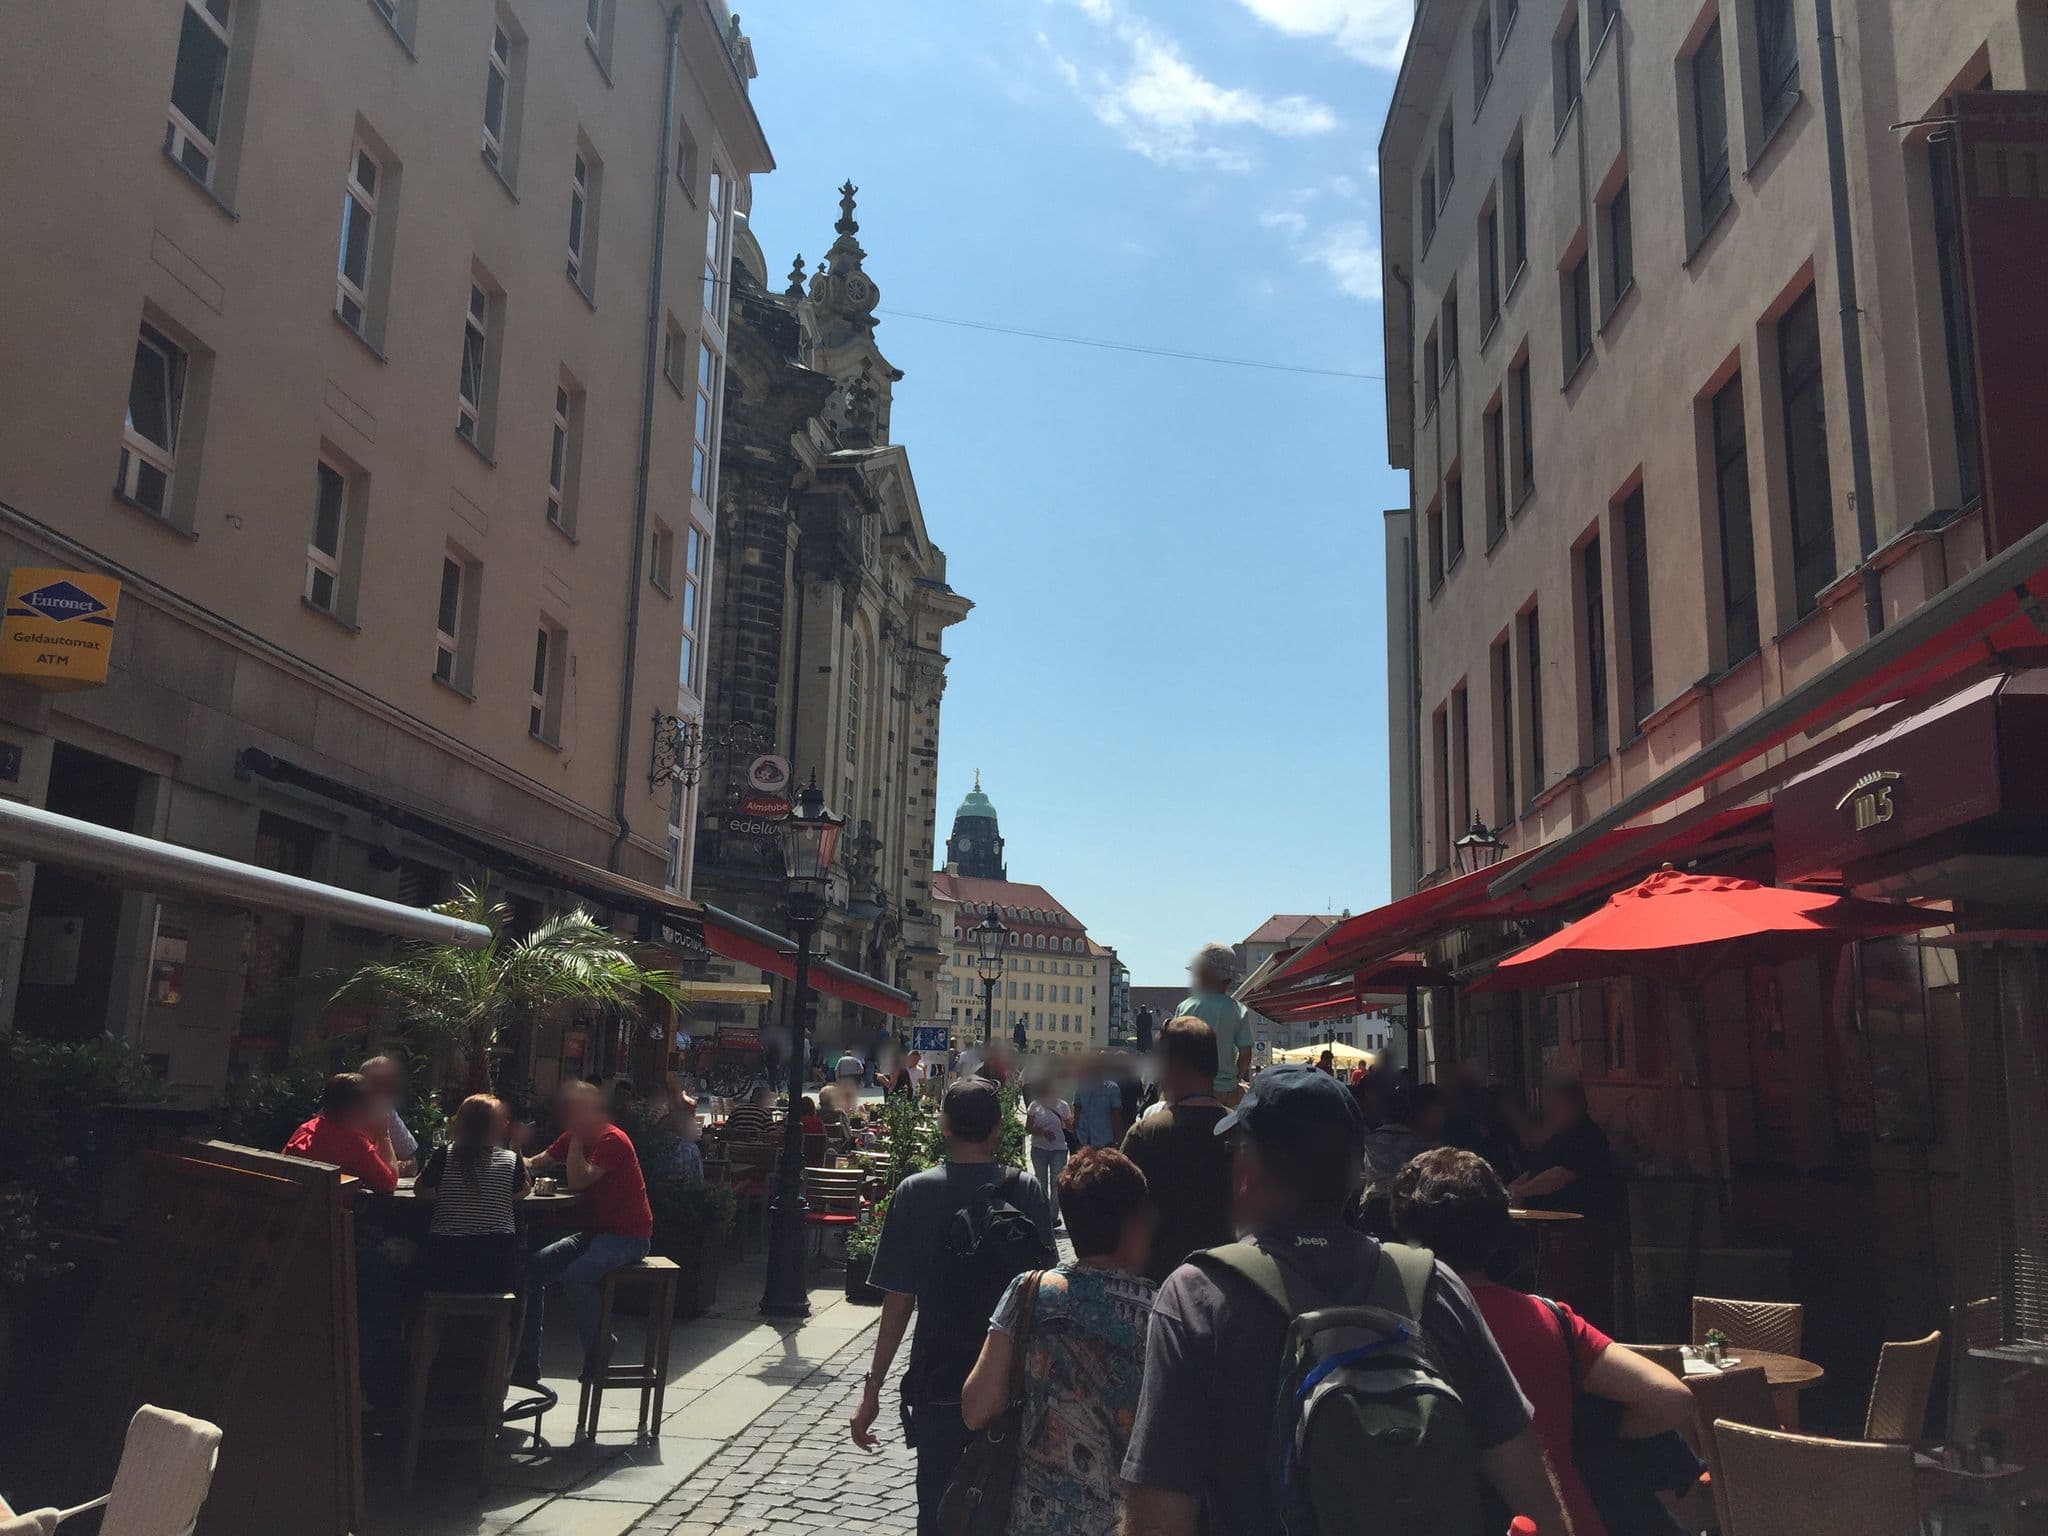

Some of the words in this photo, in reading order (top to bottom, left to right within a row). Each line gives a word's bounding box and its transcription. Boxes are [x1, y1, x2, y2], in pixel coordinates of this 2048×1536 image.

[30, 592, 95, 612] Euronet
[13, 631, 101, 651] Geldautomat
[36, 653, 69, 666] ATM
[746, 801, 788, 812] Almstube
[1294, 1236, 1328, 1248] Jeep
